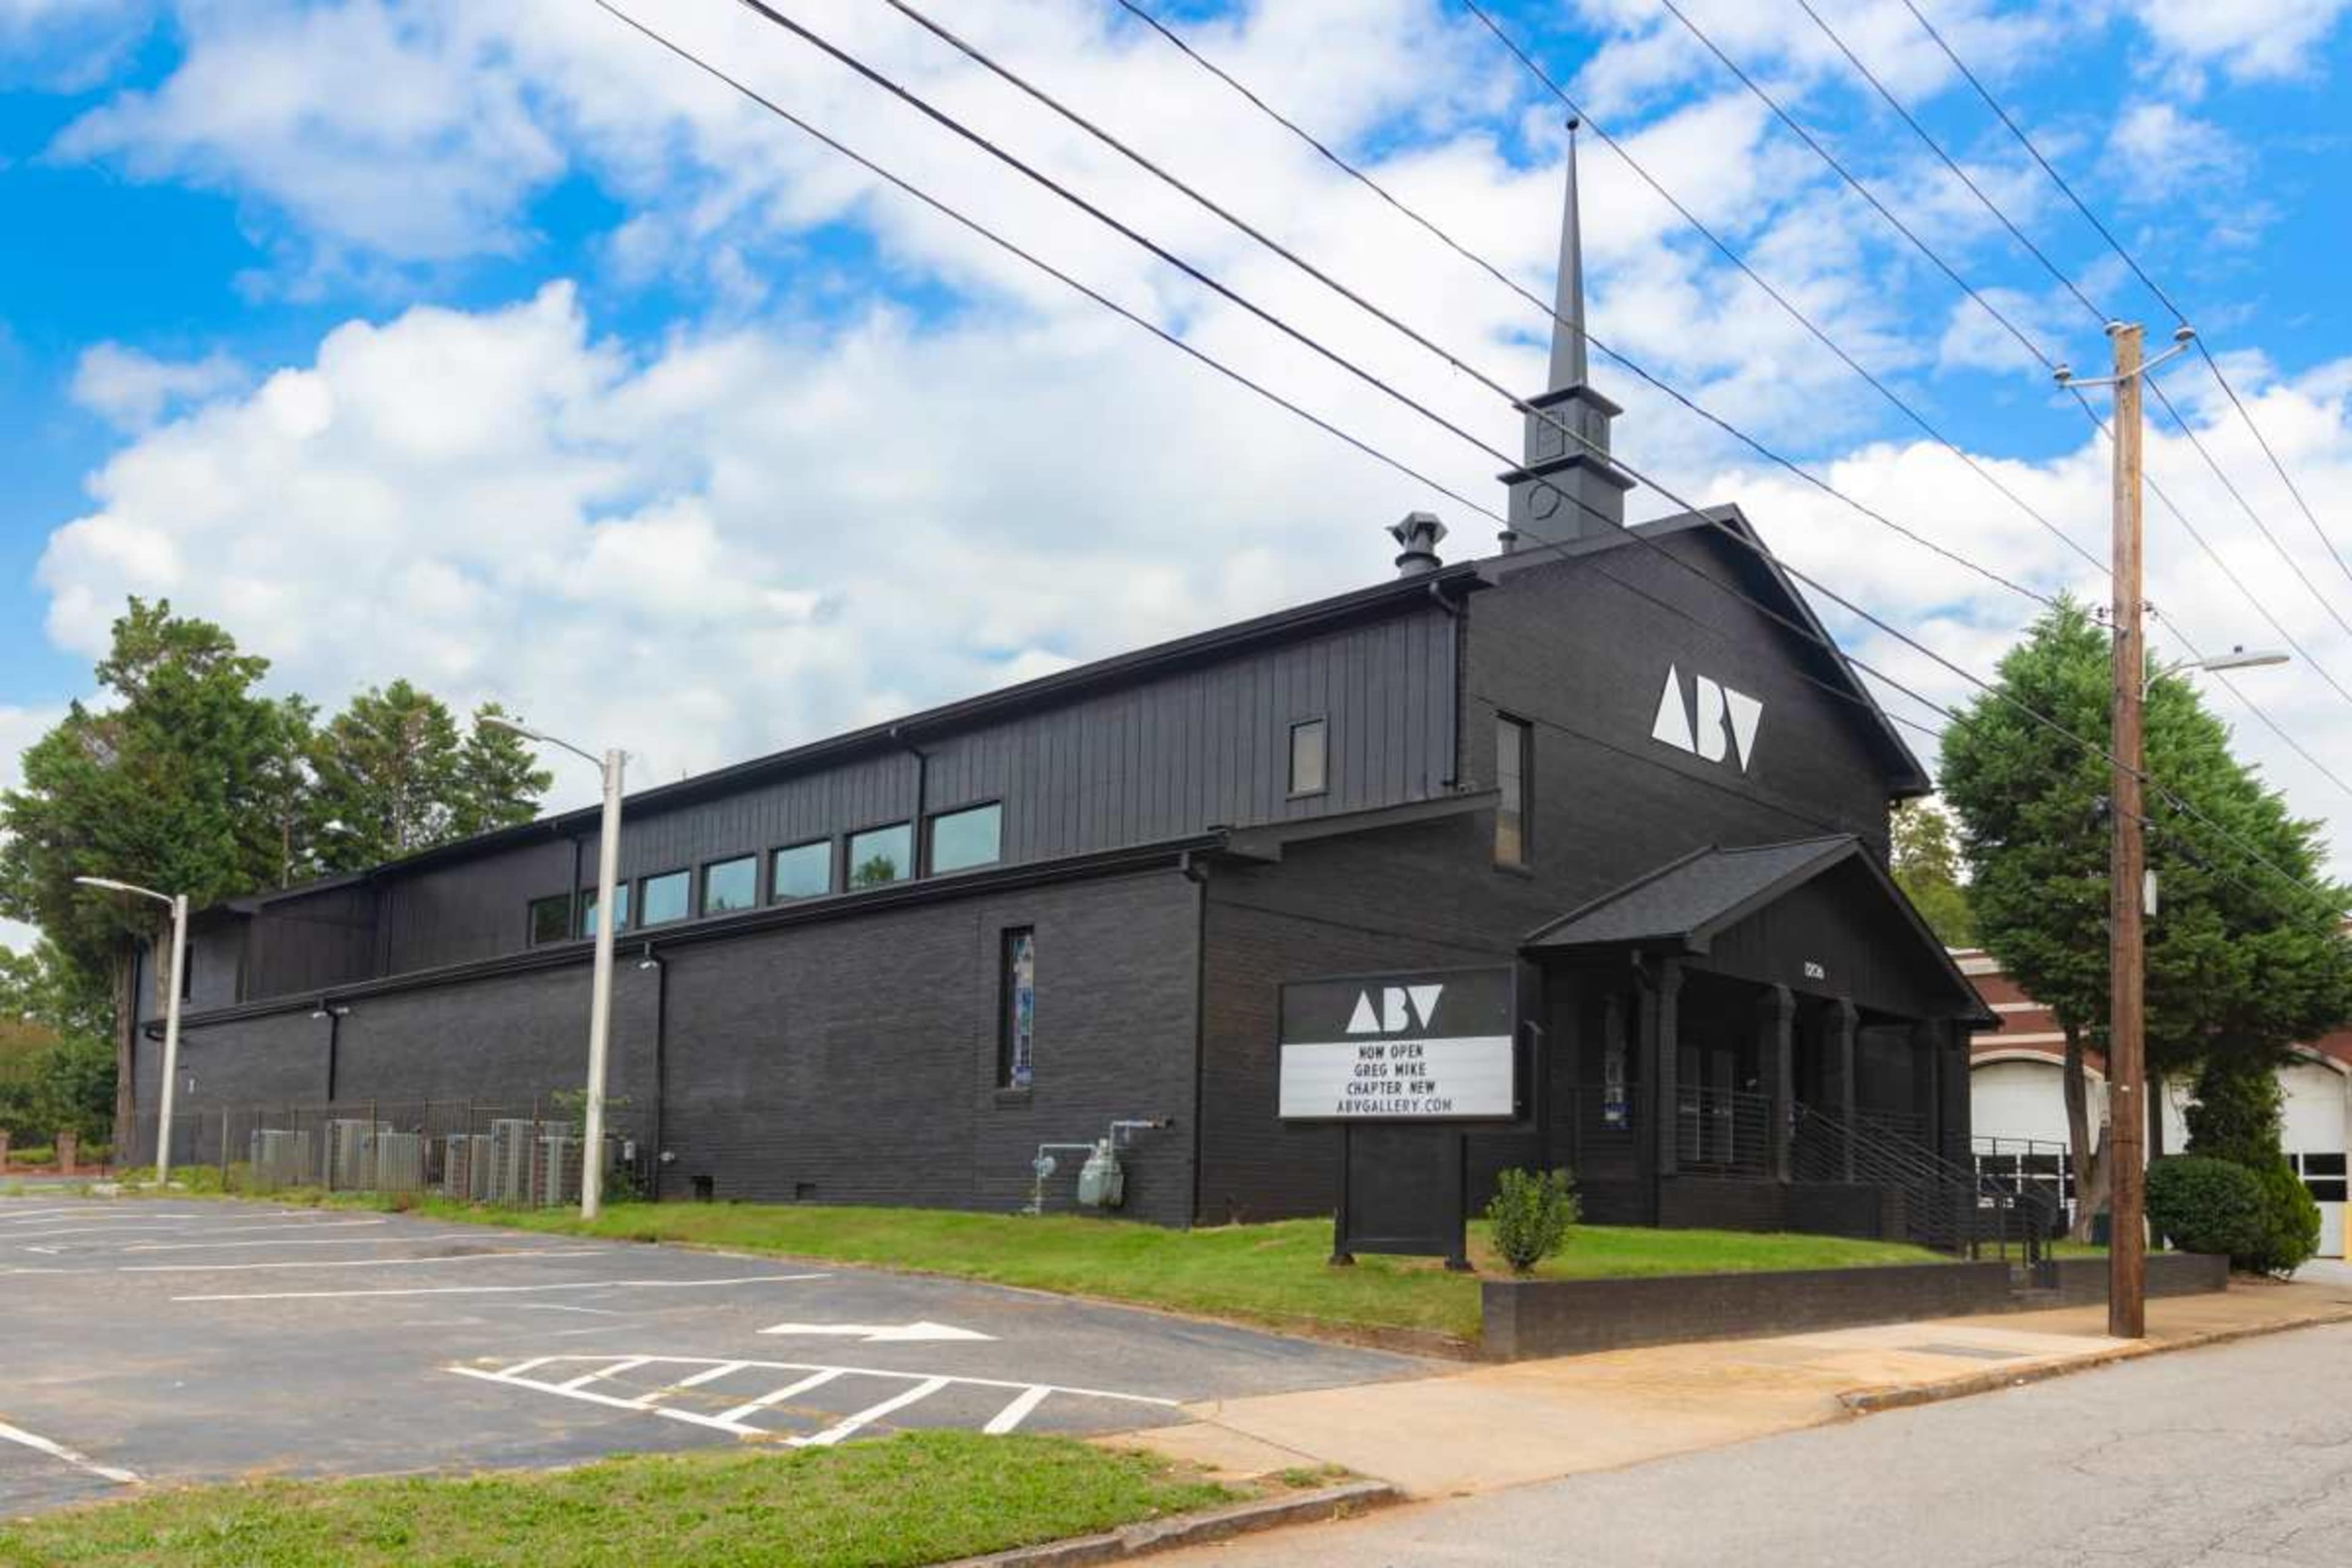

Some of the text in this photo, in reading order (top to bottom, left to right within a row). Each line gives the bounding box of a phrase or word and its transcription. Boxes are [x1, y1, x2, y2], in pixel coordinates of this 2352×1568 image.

[1651, 662, 1763, 774] ABV
[1345, 984, 1444, 1033] ABV
[1359, 1044, 1424, 1059] NOW OPEN
[1354, 1063, 1427, 1077] GREG MIKE
[1347, 1081, 1436, 1095] CHAPTER NEW
[1336, 1099, 1452, 1114] ABVGALLERY.COM
